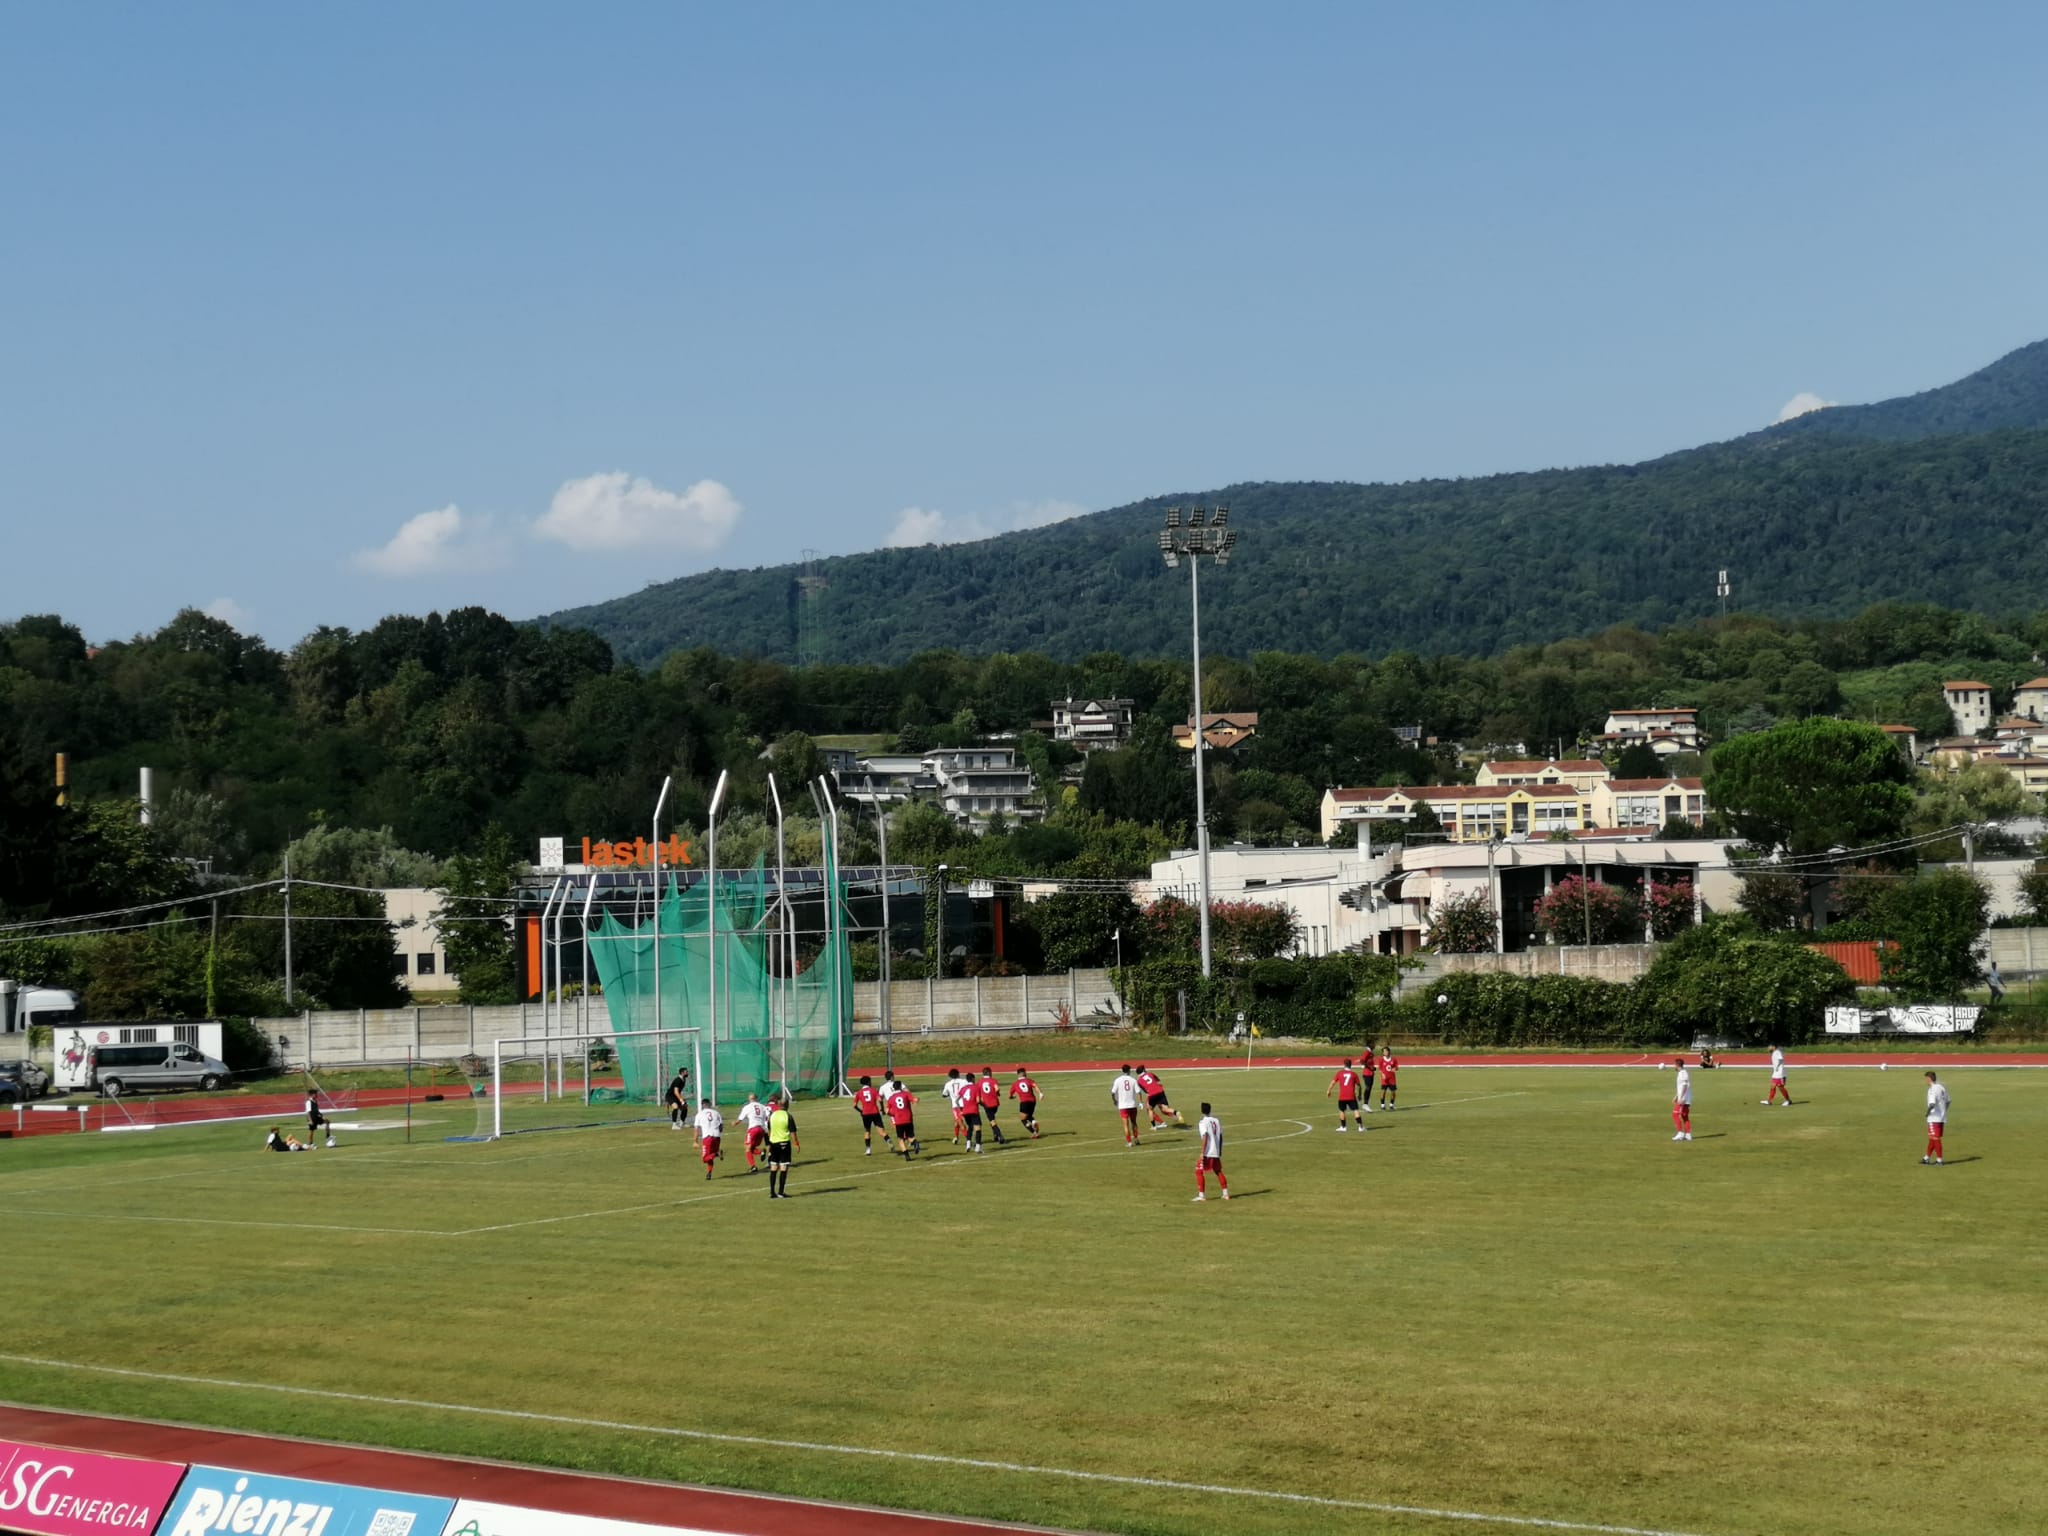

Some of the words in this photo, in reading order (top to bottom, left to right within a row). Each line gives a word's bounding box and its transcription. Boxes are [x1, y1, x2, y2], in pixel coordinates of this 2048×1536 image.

[582, 833, 692, 867] lastek
[1018, 1081, 1029, 1093] 9
[1124, 1079, 1131, 1092] 8
[1343, 1073, 1352, 1087] 7
[982, 1081, 991, 1094] 6
[962, 1088, 971, 1102] 4
[895, 1096, 905, 1110] 8
[54, 1495, 150, 1529] ENERGIA
